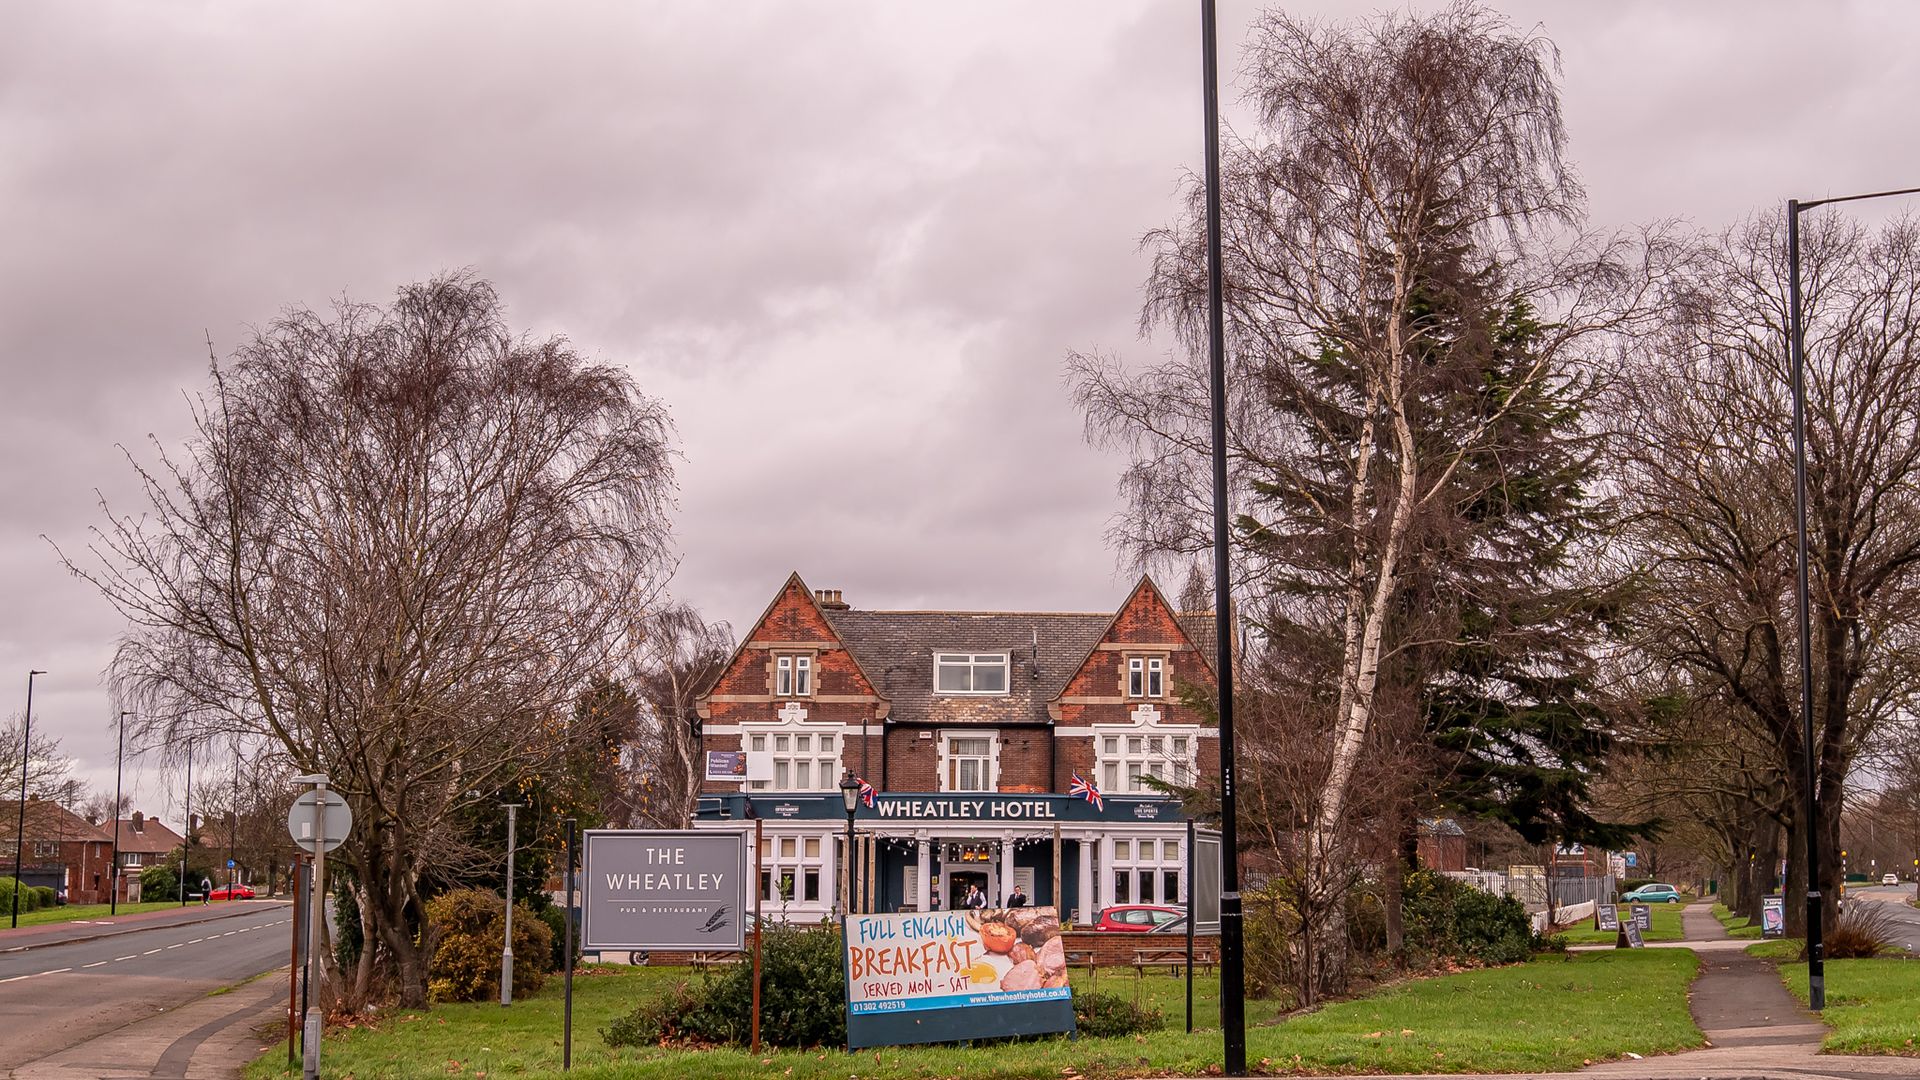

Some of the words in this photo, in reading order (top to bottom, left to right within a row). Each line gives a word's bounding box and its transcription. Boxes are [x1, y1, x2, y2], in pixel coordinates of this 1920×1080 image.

[877, 801, 984, 817] WHEATLEY
[991, 801, 1056, 818] HOTEL
[646, 848, 685, 865] THE
[606, 873, 724, 890] WHEATLEY
[859, 918, 896, 944] FULL
[902, 915, 965, 940] ENGLISH
[849, 940, 977, 980] BREAKFAST
[863, 981, 903, 998] SERVED
[908, 979, 932, 995] MON
[950, 976, 971, 992] SAT
[969, 988, 1068, 1004] www.thewheatleyhotel.co.uk
[853, 1002, 877, 1011] 01302
[878, 1001, 906, 1010] 492519
